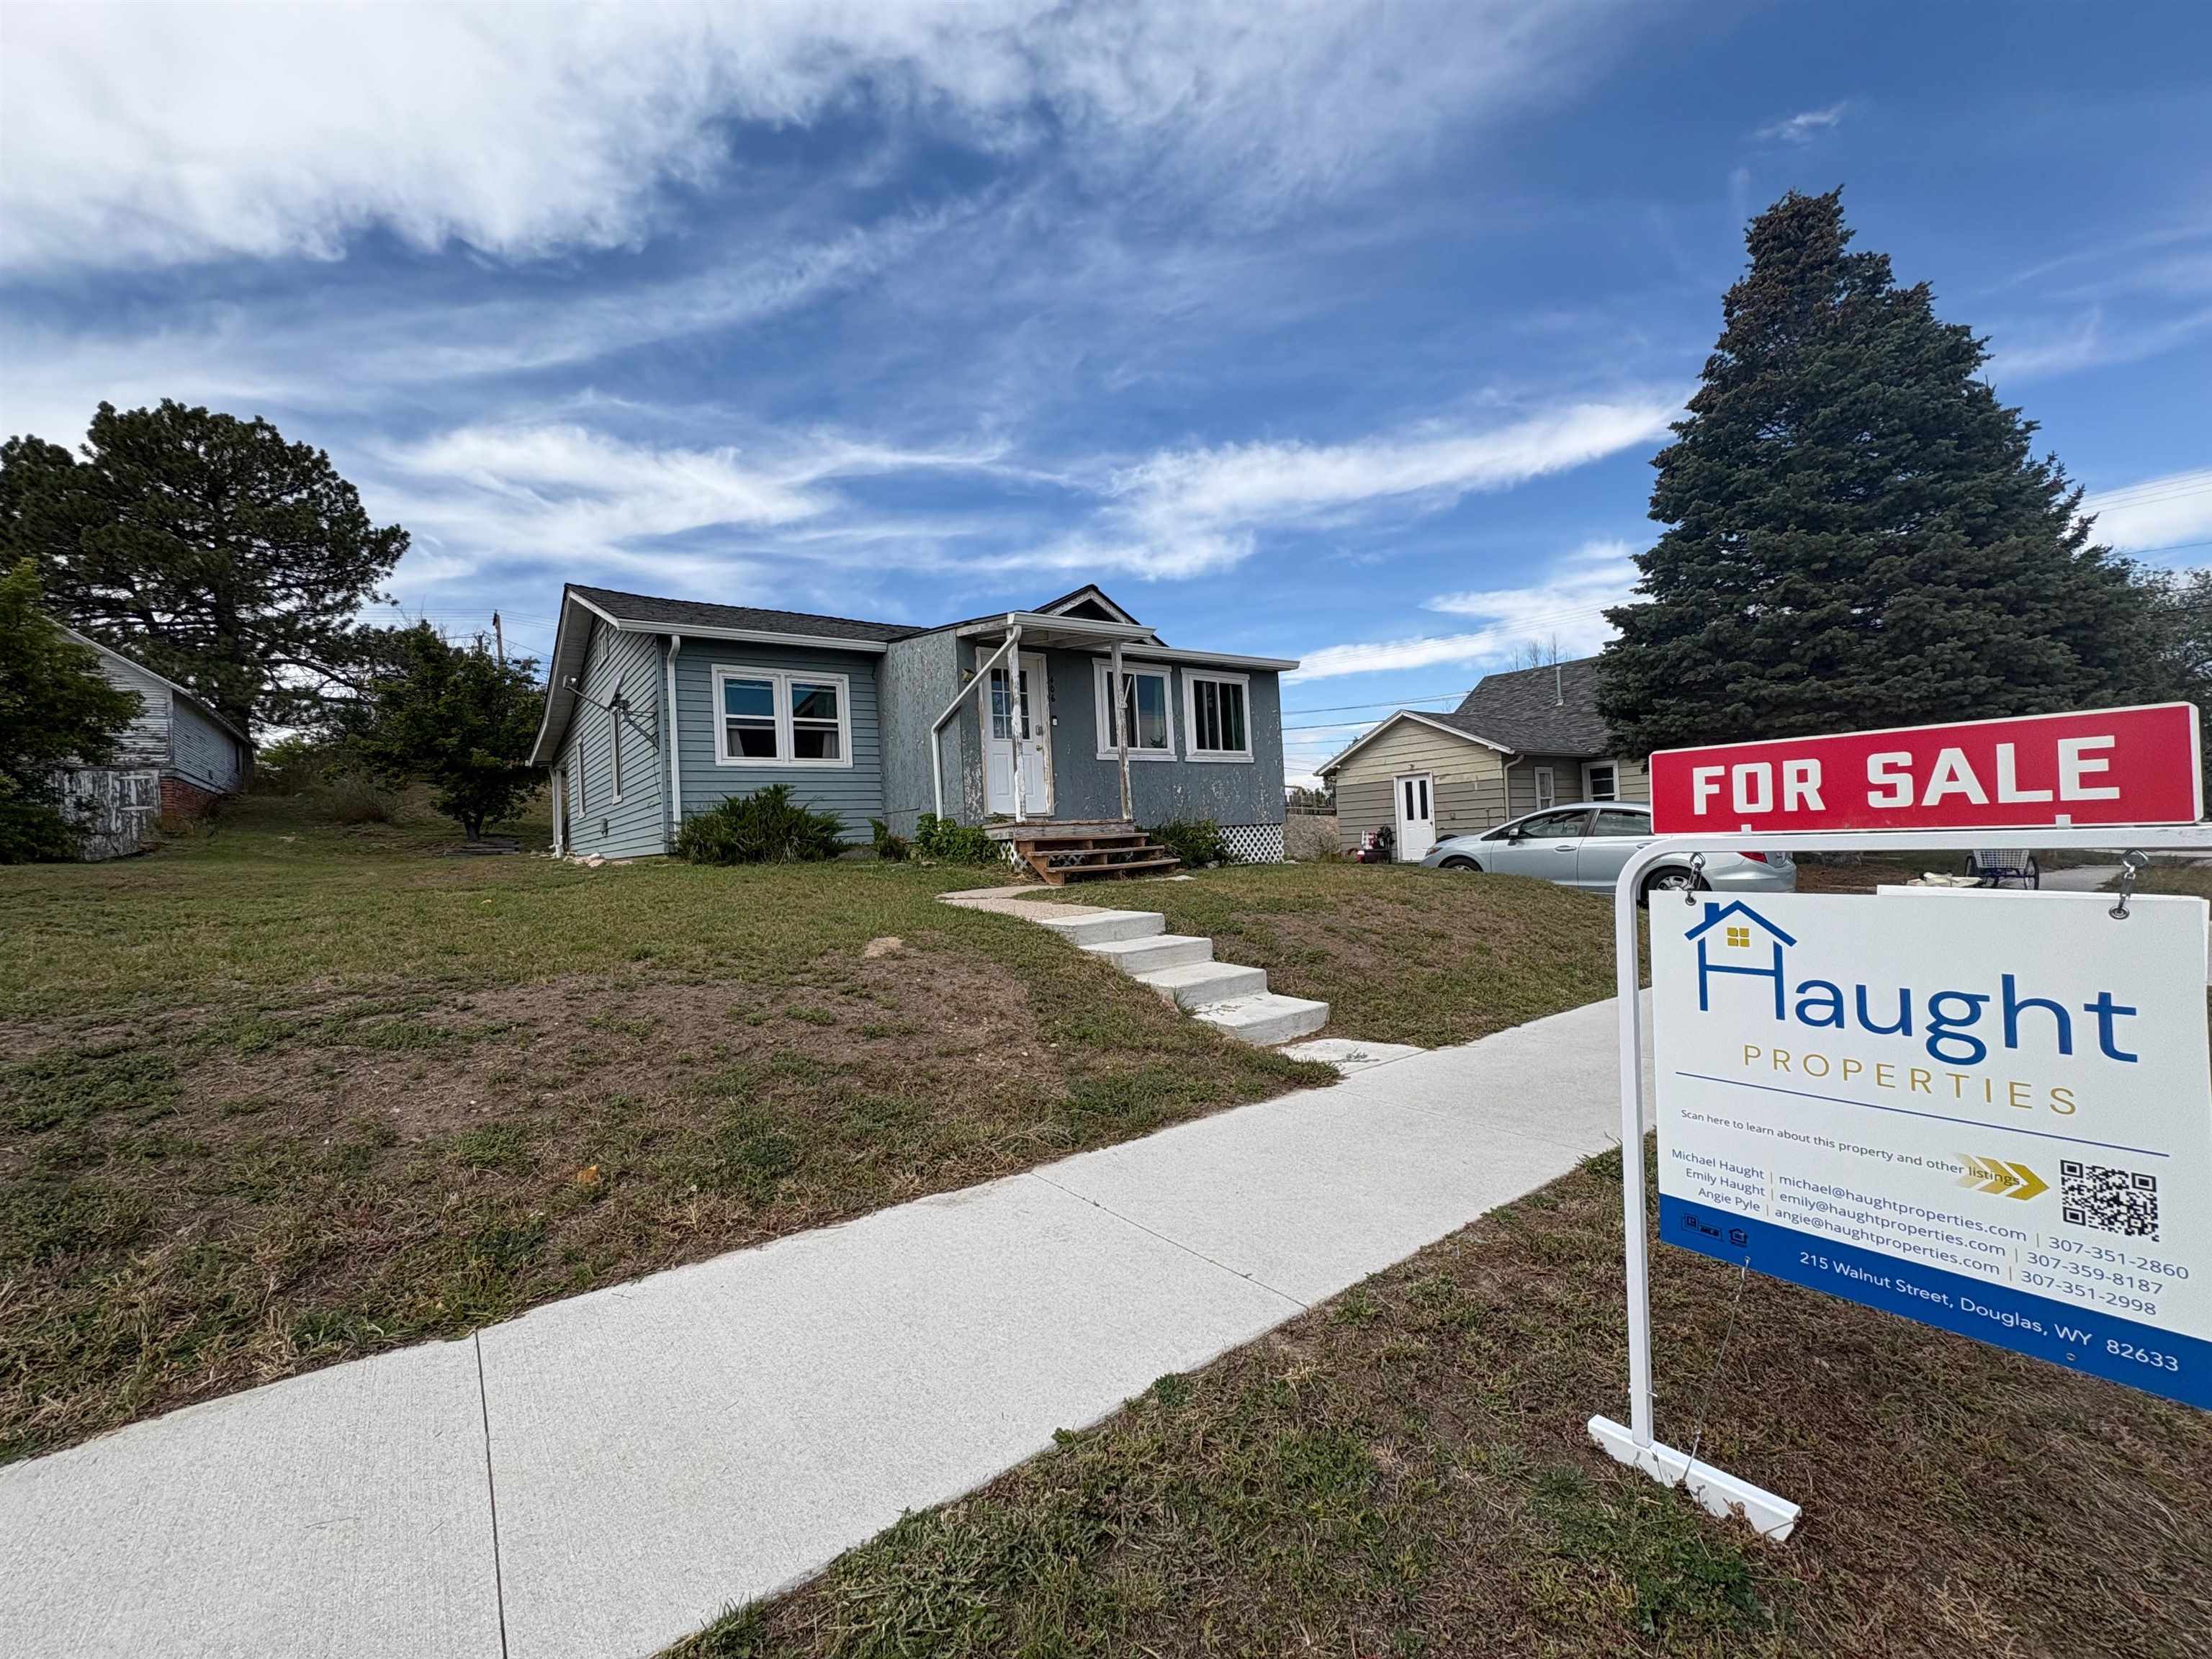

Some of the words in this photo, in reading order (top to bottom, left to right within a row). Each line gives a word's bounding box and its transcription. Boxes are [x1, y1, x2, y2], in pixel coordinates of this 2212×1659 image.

[1692, 758, 1826, 815] FOR
[1867, 735, 2120, 808] SALE
[1697, 933, 2138, 1065] Haught
[1681, 1109, 1704, 1122] Scan
[1707, 1115, 1730, 1128] here
[1733, 1120, 1744, 1130] to
[1746, 1123, 1774, 1136] learn
[1776, 1128, 1811, 1143] about
[1814, 1136, 1835, 1148] this
[1838, 1142, 1894, 1163] property
[1897, 1154, 1923, 1166] and
[1926, 1158, 1964, 1174] other
[1743, 1044, 2078, 1117] PROPERTIES
[1671, 1148, 1716, 1168] Michael
[1719, 1157, 1765, 1179] Haught
[1779, 1174, 2028, 1242] michael@haughtproperties.com
[2048, 1236, 2189, 1280] 307-351-2860
[1686, 1167, 1717, 1186] Emily
[1720, 1176, 1766, 1197] Haught
[1779, 1192, 2006, 1257] emily@haughtproperties.com
[2027, 1251, 2164, 1295] 307-359-8187
[1698, 1187, 1732, 1205] Angie
[1735, 1197, 1761, 1213] Pyle
[1774, 1208, 2000, 1275] angie@haughtproperties.com
[2020, 1270, 2157, 1316] 307-351-2998
[1799, 1251, 1829, 1270] 215
[1833, 1260, 1892, 1289] Walnut
[1895, 1279, 1954, 1308] Street,
[1960, 1298, 2049, 1336] Douglas,
[2054, 1323, 2093, 1346] WY
[2105, 1339, 2180, 1372] 82633
